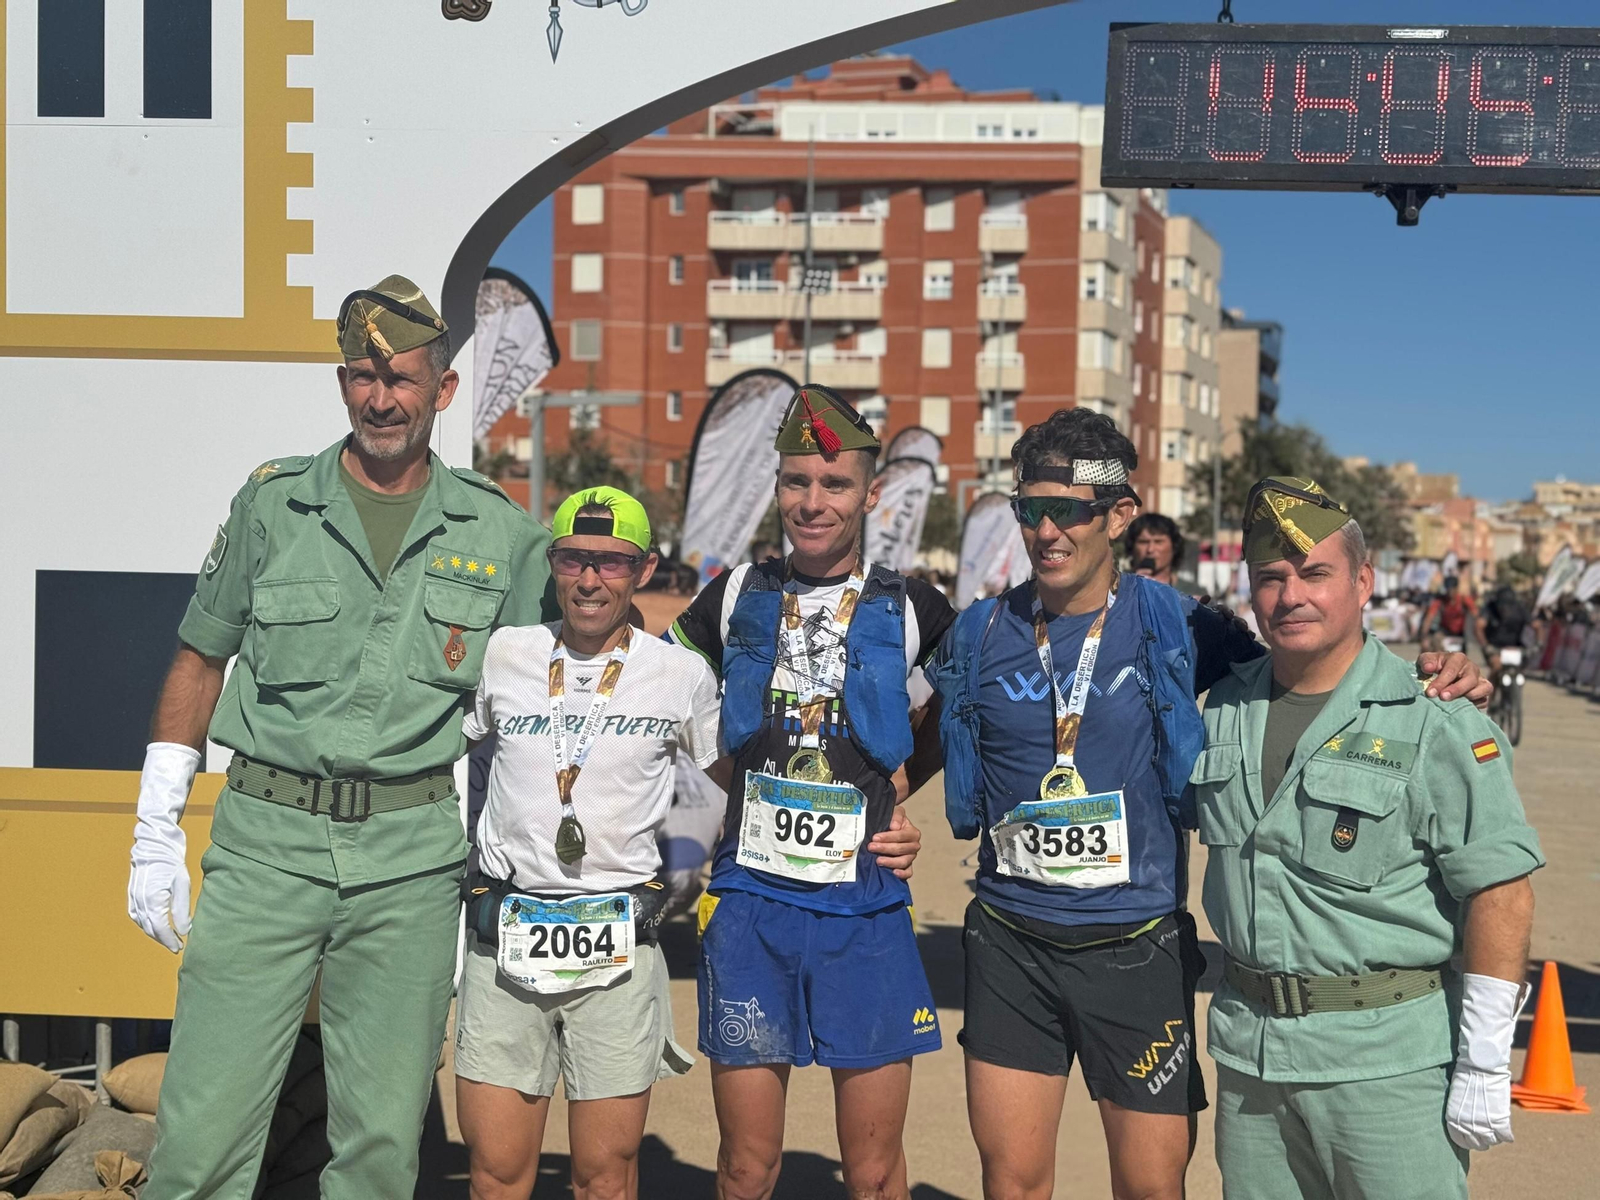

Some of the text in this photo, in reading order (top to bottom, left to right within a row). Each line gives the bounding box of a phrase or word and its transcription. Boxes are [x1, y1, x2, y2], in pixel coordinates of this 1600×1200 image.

[795, 634, 803, 646] LA
[1087, 644, 1098, 672] EDICION
[1071, 647, 1092, 707] LA DESERTICA
[502, 714, 680, 738] SIEMRE FUERTE
[552, 705, 563, 764] LA DESERTICA
[574, 703, 600, 759] LA DESERTICA
[1346, 750, 1402, 769] CARRERAS
[774, 808, 836, 848] 962
[1022, 823, 1108, 857] 3583
[825, 850, 842, 858] ELOY
[529, 924, 615, 959] 2064
[582, 958, 613, 967] RAULITO
